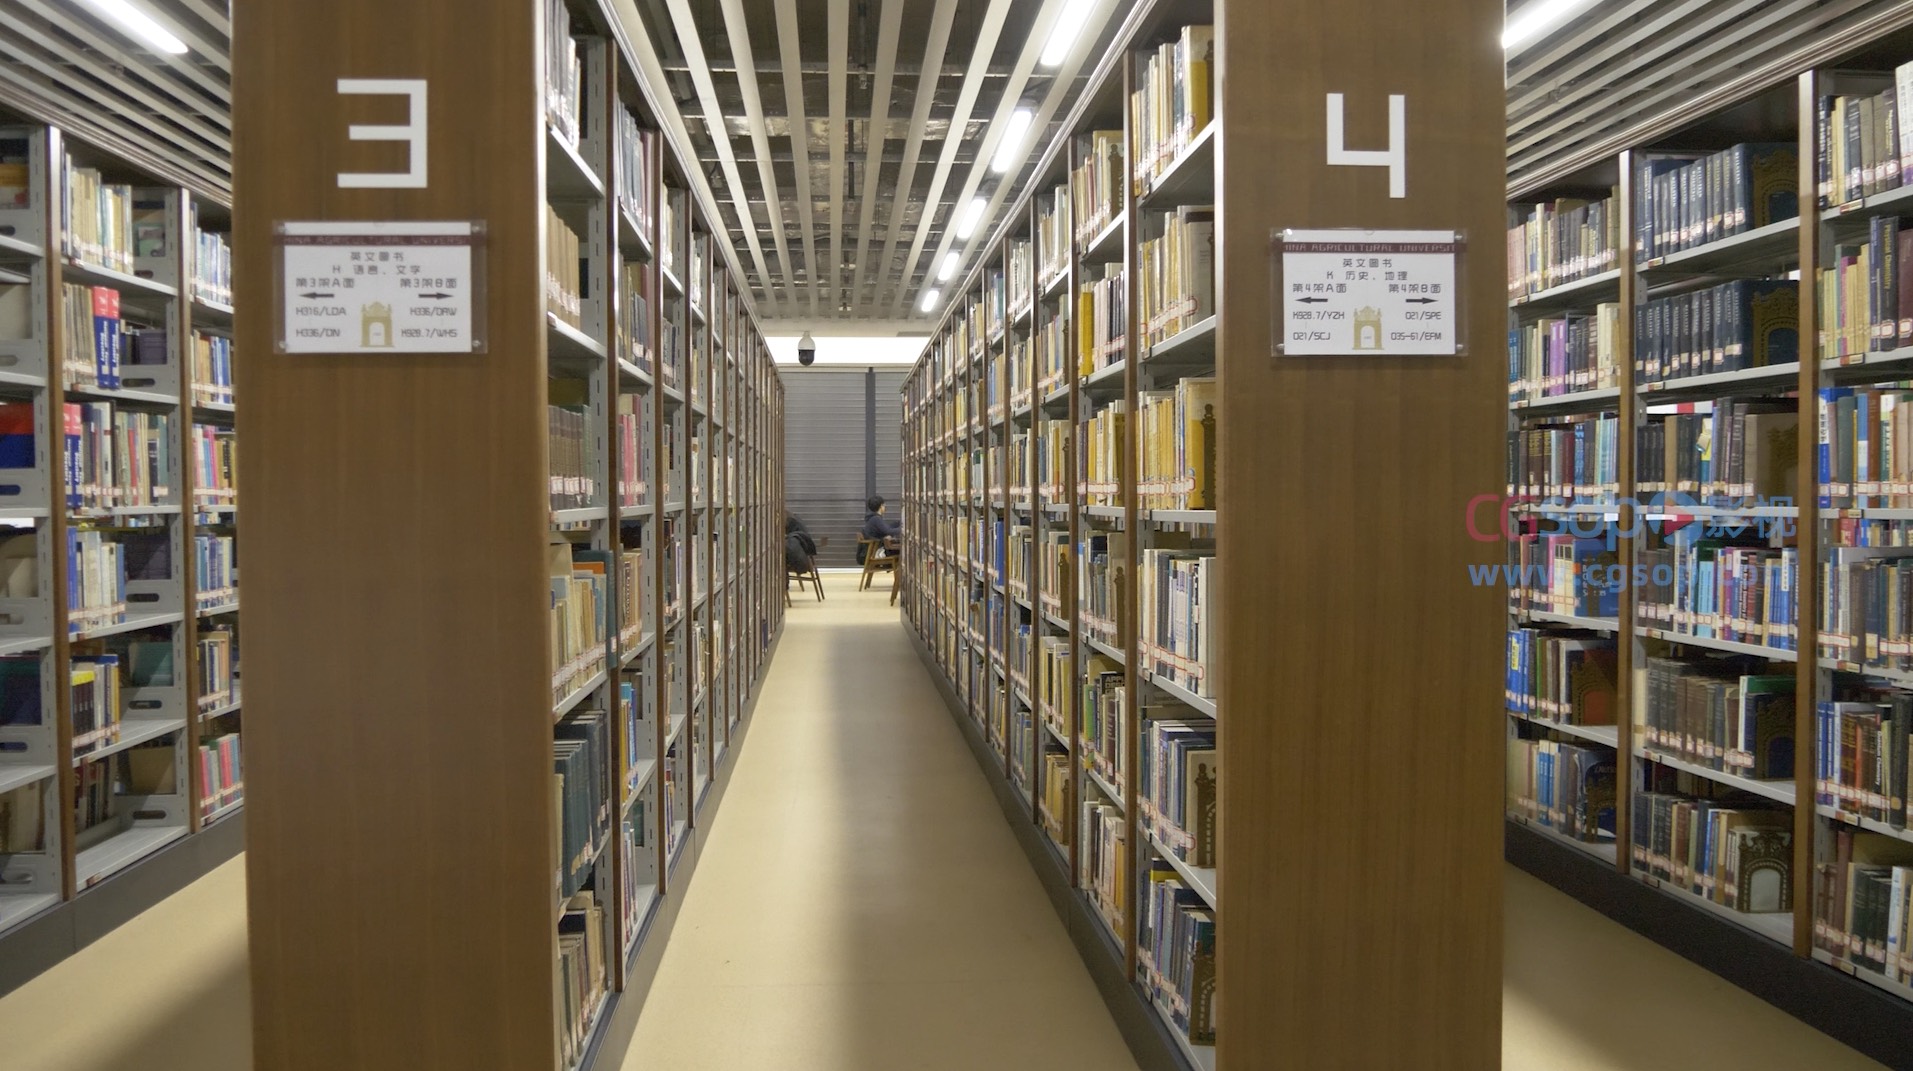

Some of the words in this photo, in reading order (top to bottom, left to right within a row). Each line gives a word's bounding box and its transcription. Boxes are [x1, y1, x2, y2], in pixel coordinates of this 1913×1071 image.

[337, 79, 427, 188] 3
[1326, 93, 1405, 198] 4
[332, 265, 341, 274] H
[1326, 271, 1334, 280] K
[1293, 283, 1347, 293] 第4架A面
[1388, 283, 1442, 294] 第4架B面
